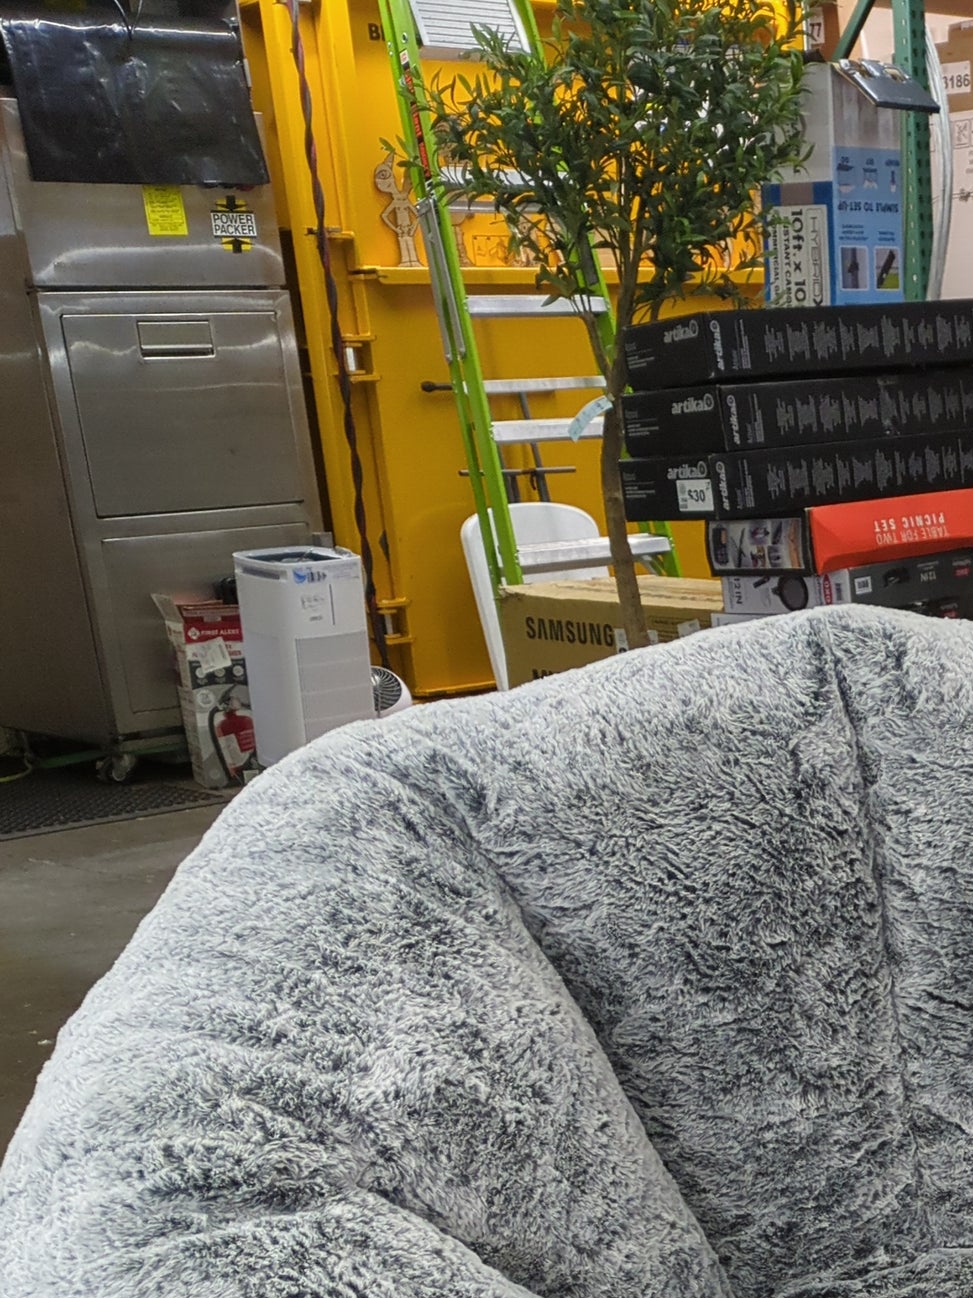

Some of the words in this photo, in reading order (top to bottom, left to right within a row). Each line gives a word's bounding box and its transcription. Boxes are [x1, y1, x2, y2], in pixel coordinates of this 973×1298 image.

[212, 213, 253, 225] POWER
[214, 225, 256, 235] PACKER
[873, 518, 896, 533] SET
[901, 511, 946, 529] PICNIC
[874, 532, 899, 545] TWO
[899, 528, 919, 543] FOR
[919, 526, 949, 540] TABLE
[525, 616, 615, 647] SAMSUNG
